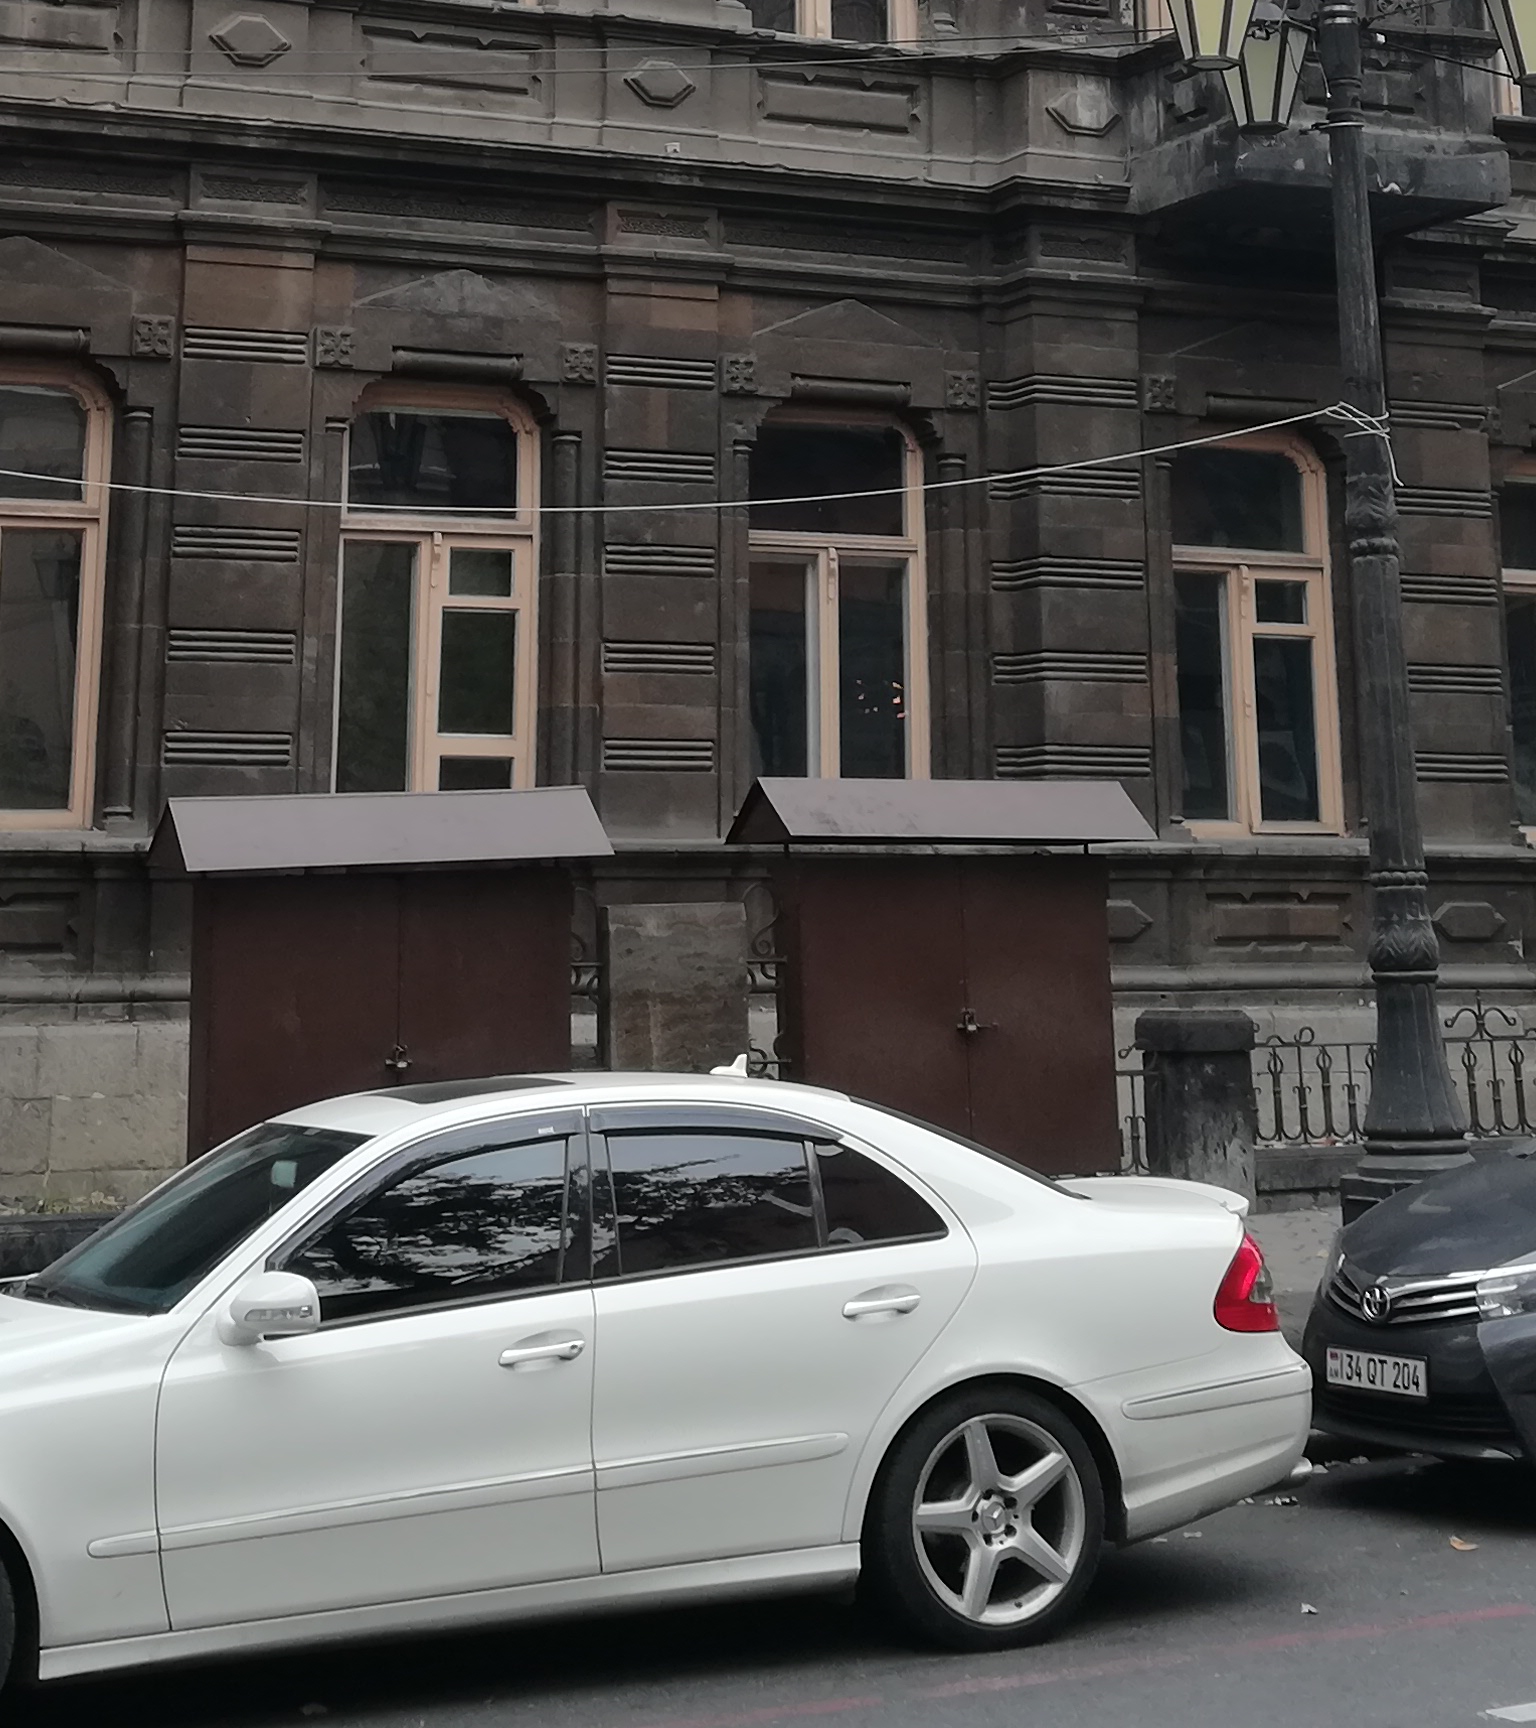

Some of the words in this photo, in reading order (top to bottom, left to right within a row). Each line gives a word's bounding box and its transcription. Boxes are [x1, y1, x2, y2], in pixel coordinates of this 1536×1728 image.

[1345, 1353, 1362, 1383] 34
[1367, 1357, 1388, 1387] QT
[1392, 1361, 1420, 1393] 204
